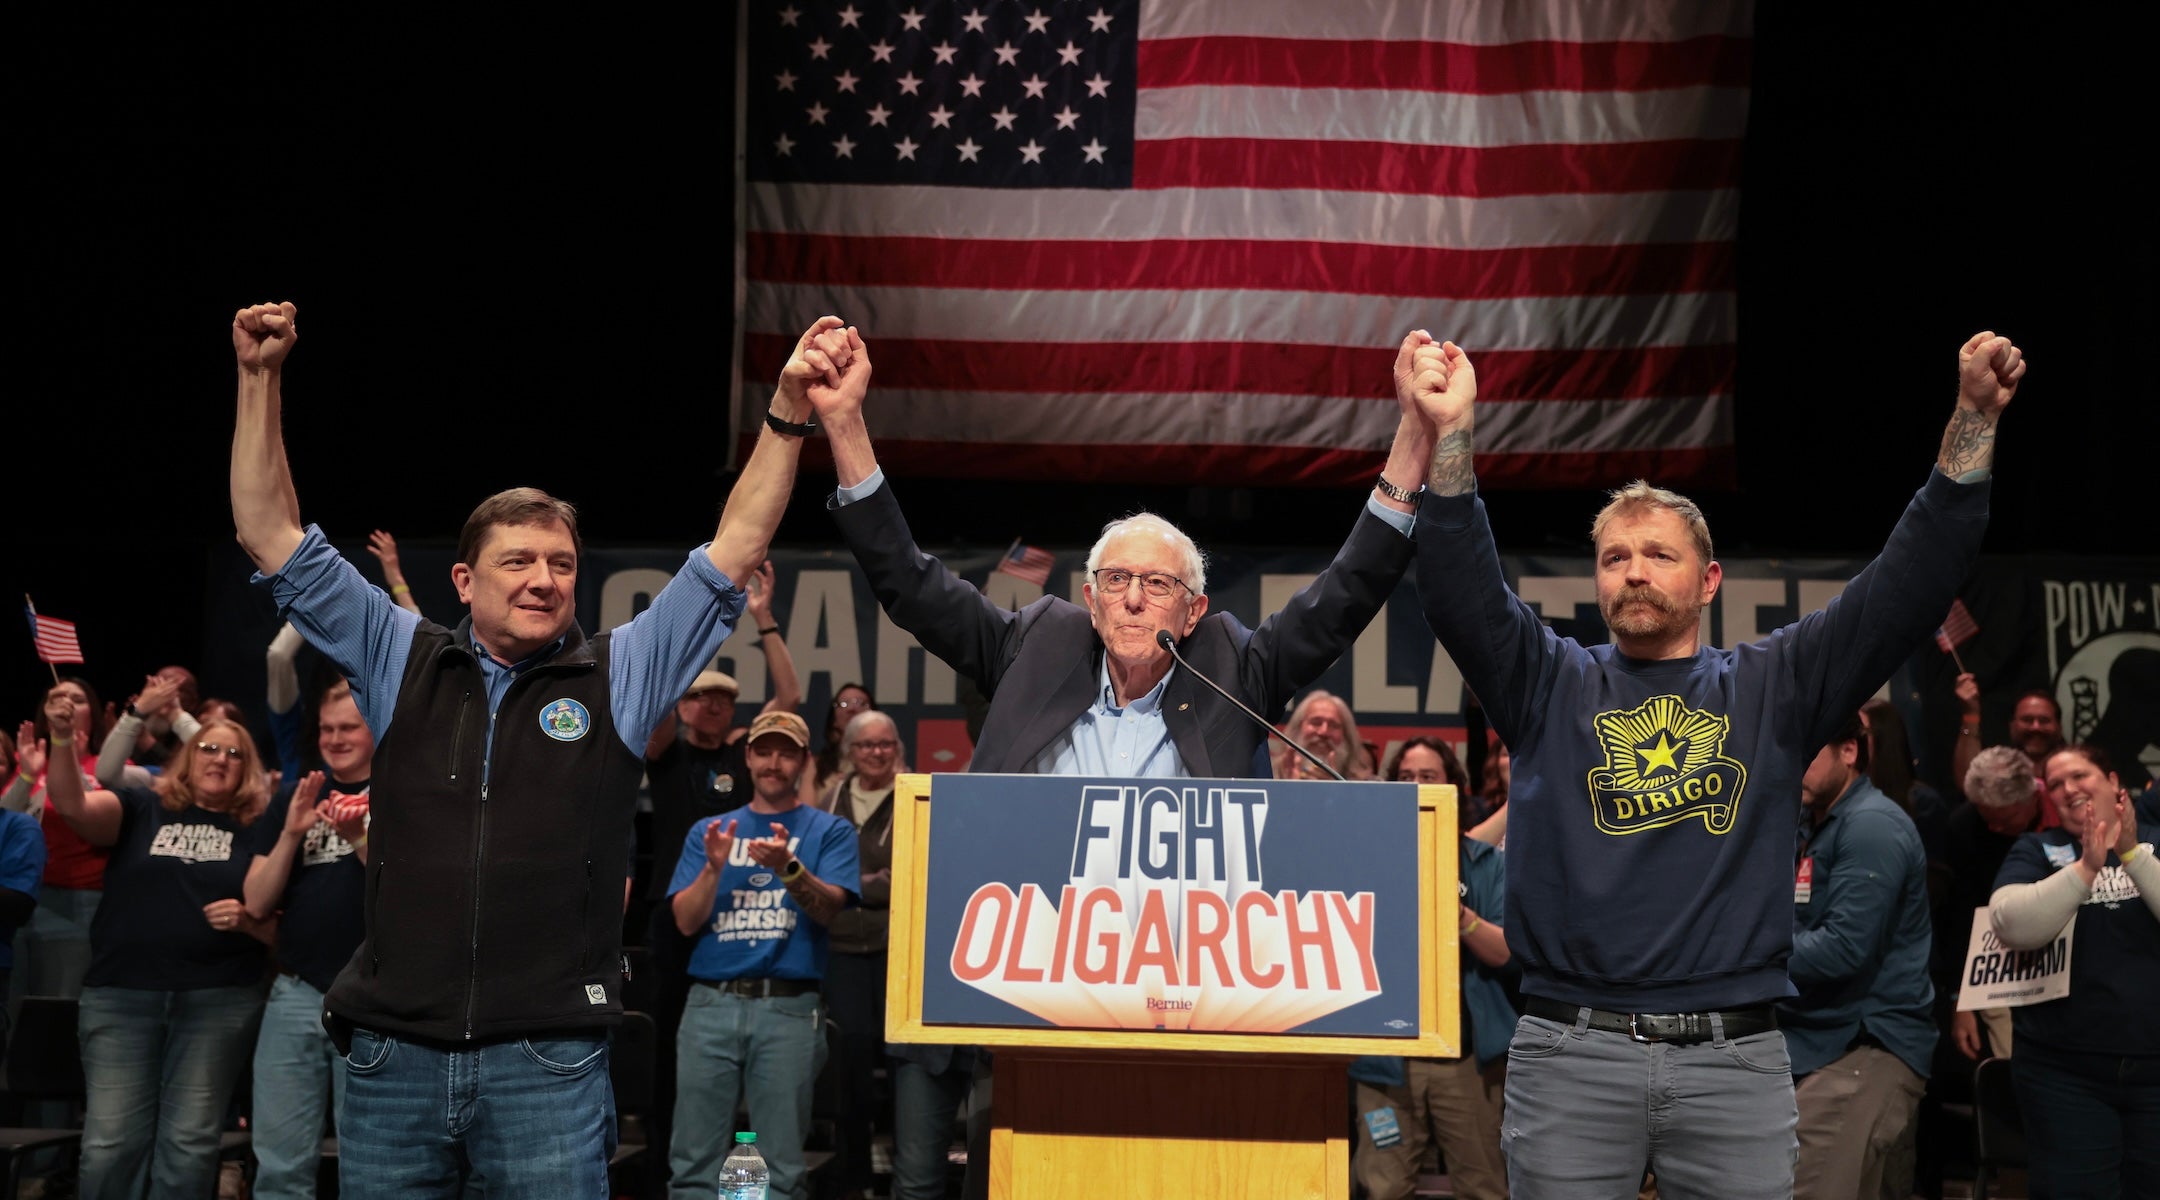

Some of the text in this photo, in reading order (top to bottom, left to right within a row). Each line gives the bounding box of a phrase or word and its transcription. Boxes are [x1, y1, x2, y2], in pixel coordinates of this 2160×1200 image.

[2044, 581, 2127, 683] POW
[1613, 772, 1723, 820] DIRIGO
[1071, 787, 1269, 883] FIGHT
[712, 908, 798, 933] JACKSON
[731, 888, 787, 909] TROY
[951, 884, 1382, 992] OLIGARCHY
[1969, 937, 2067, 987] GRAHAM
[1145, 997, 1193, 1011] Bernie
